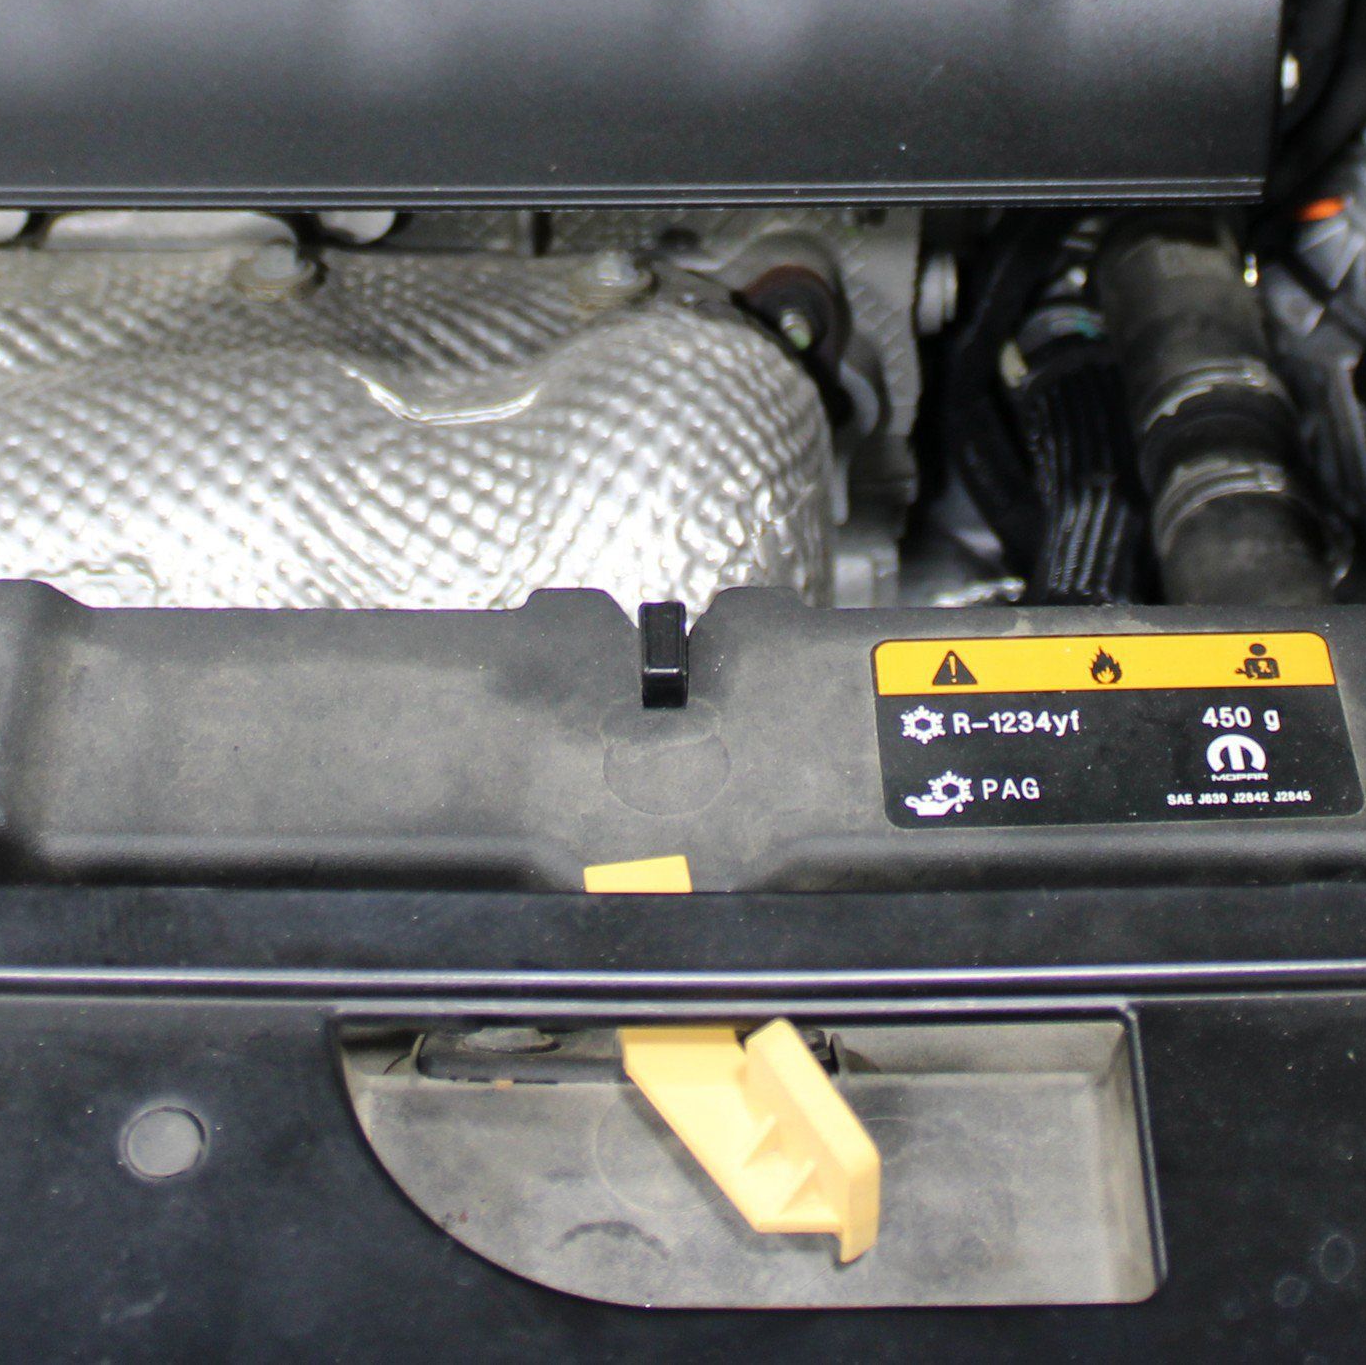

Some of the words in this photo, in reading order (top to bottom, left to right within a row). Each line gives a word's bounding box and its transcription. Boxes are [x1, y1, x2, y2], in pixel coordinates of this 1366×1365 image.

[951, 709, 1080, 737] R-1234yf
[1201, 705, 1252, 729] 450
[1263, 709, 1281, 732] g
[981, 776, 1041, 801] PAG
[1210, 772, 1269, 782] MOPAR
[1166, 792, 1194, 806] SAE
[1231, 791, 1271, 805] J2842
[1273, 790, 1313, 803] J2845
